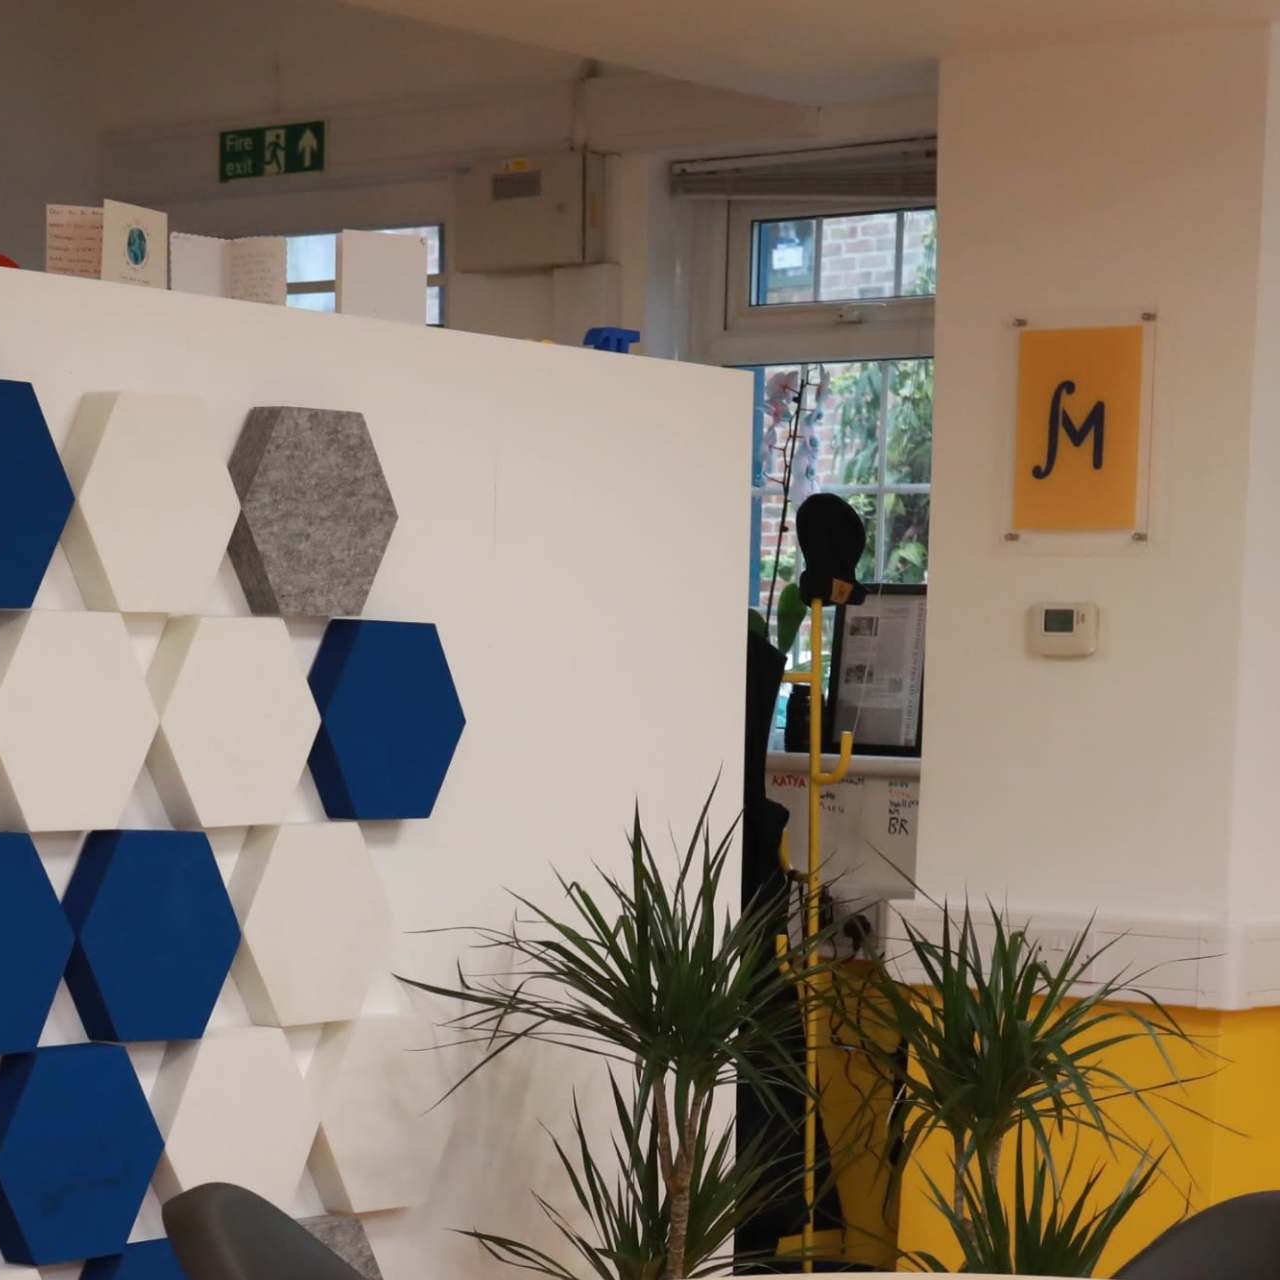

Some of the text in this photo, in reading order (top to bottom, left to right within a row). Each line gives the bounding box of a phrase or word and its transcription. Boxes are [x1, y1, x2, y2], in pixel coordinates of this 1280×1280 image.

[225, 134, 253, 152] Fire
[225, 157, 253, 176] exit
[772, 775, 806, 788] KATYA
